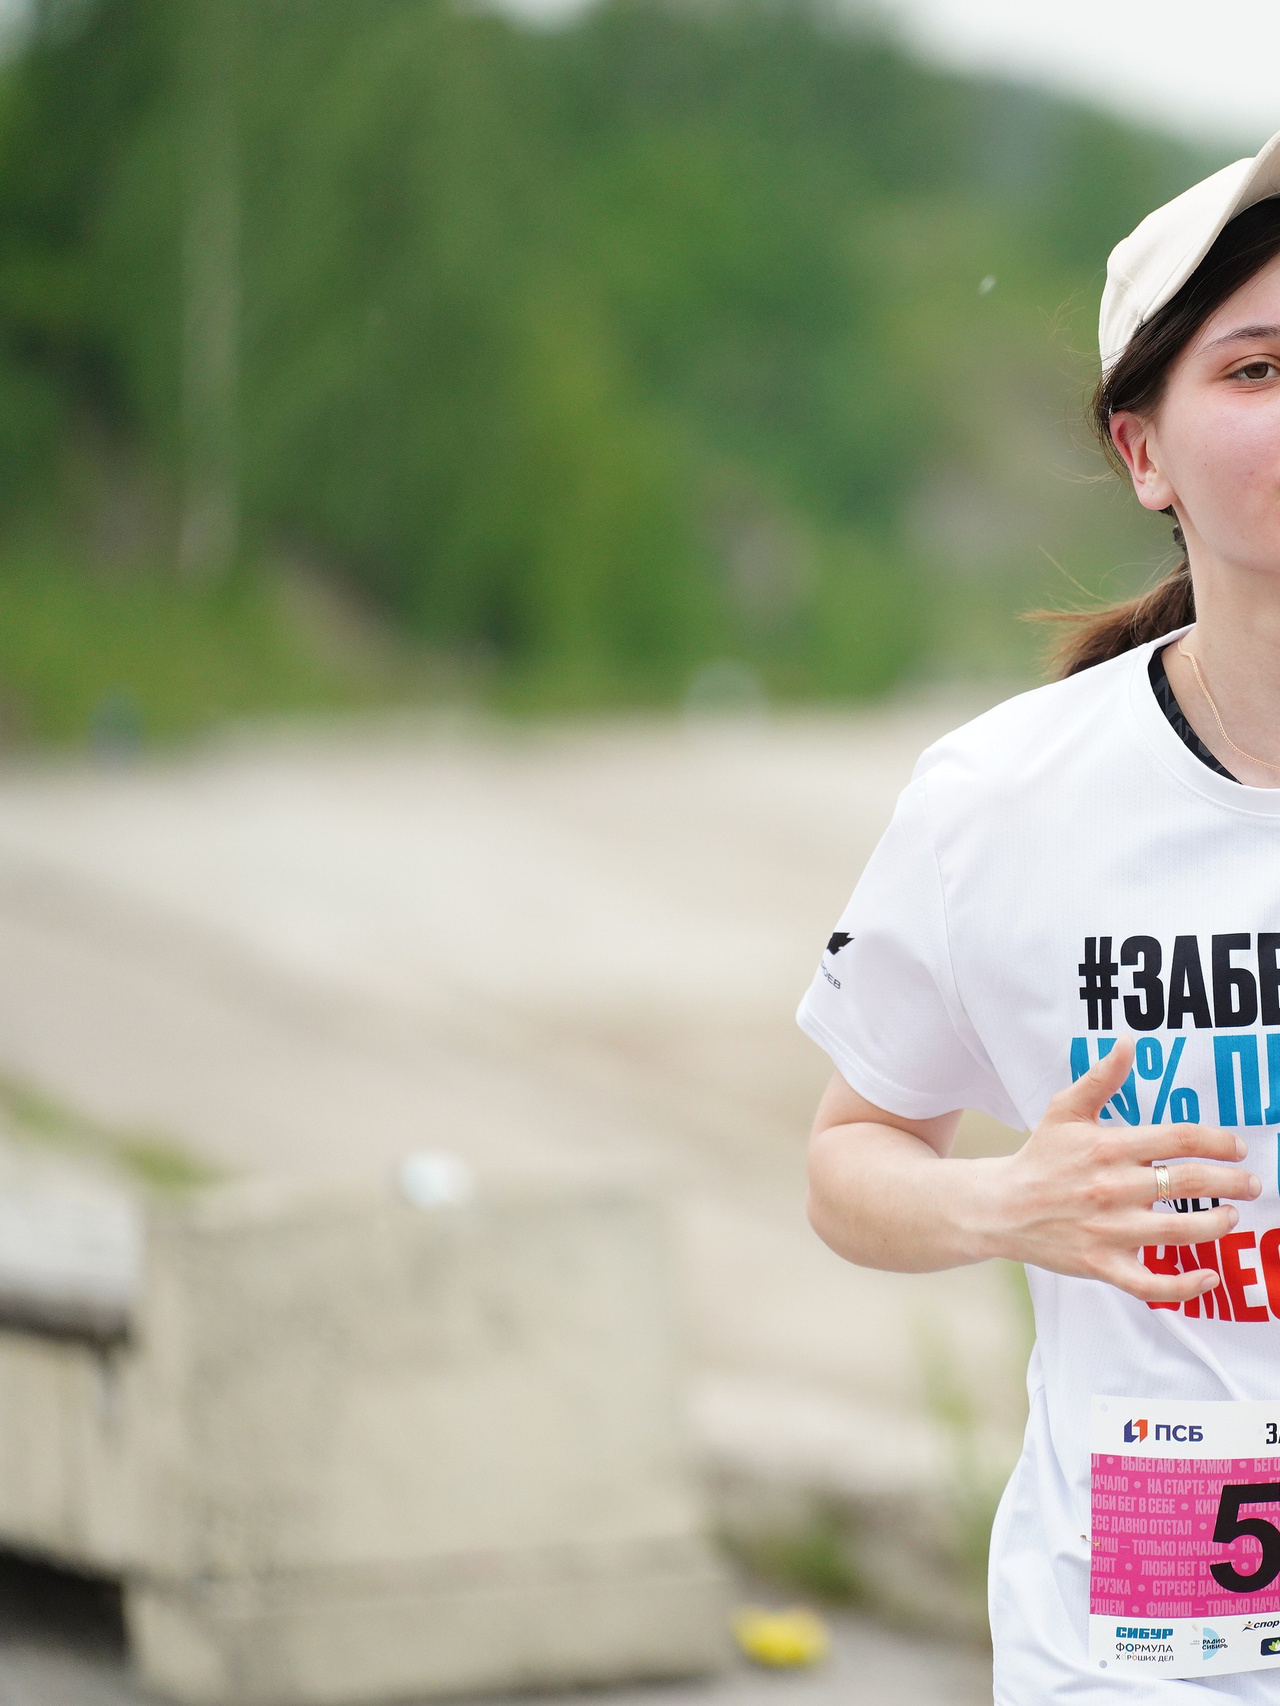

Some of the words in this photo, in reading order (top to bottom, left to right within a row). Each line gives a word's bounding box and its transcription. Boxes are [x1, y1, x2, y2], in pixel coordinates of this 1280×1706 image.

[1155, 1424, 1204, 1443] ПСБ
[1121, 1456, 1175, 1473] ВЫБЕГАЮ
[1177, 1458, 1191, 1474] ЗА
[1193, 1459, 1232, 1474] РАМКИ
[1147, 1478, 1163, 1494] НА
[1163, 1479, 1205, 1495] СТАРТЕ
[1118, 1495, 1138, 1512] БЕГ
[1138, 1497, 1147, 1513] В
[1148, 1498, 1176, 1514] СЕБЕ
[1110, 1516, 1148, 1534] ДАВНО
[1149, 1518, 1192, 1535] ОТСТАЛ
[1132, 1539, 1177, 1556] ТОЛЬКО
[1178, 1540, 1223, 1556] НАЧАЛО
[1242, 1538, 1257, 1554] НА
[1141, 1559, 1176, 1577] ЛЮБИ
[1177, 1560, 1198, 1577] БЕГ
[1199, 1560, 1207, 1576] В
[1152, 1580, 1196, 1596] СТРЕСС
[1146, 1601, 1192, 1617] ФИНИШ
[1206, 1598, 1251, 1616] ТОЛЬКО
[1115, 1626, 1174, 1640] СИБУР
[1115, 1642, 1174, 1653] ФОРМУЛА
